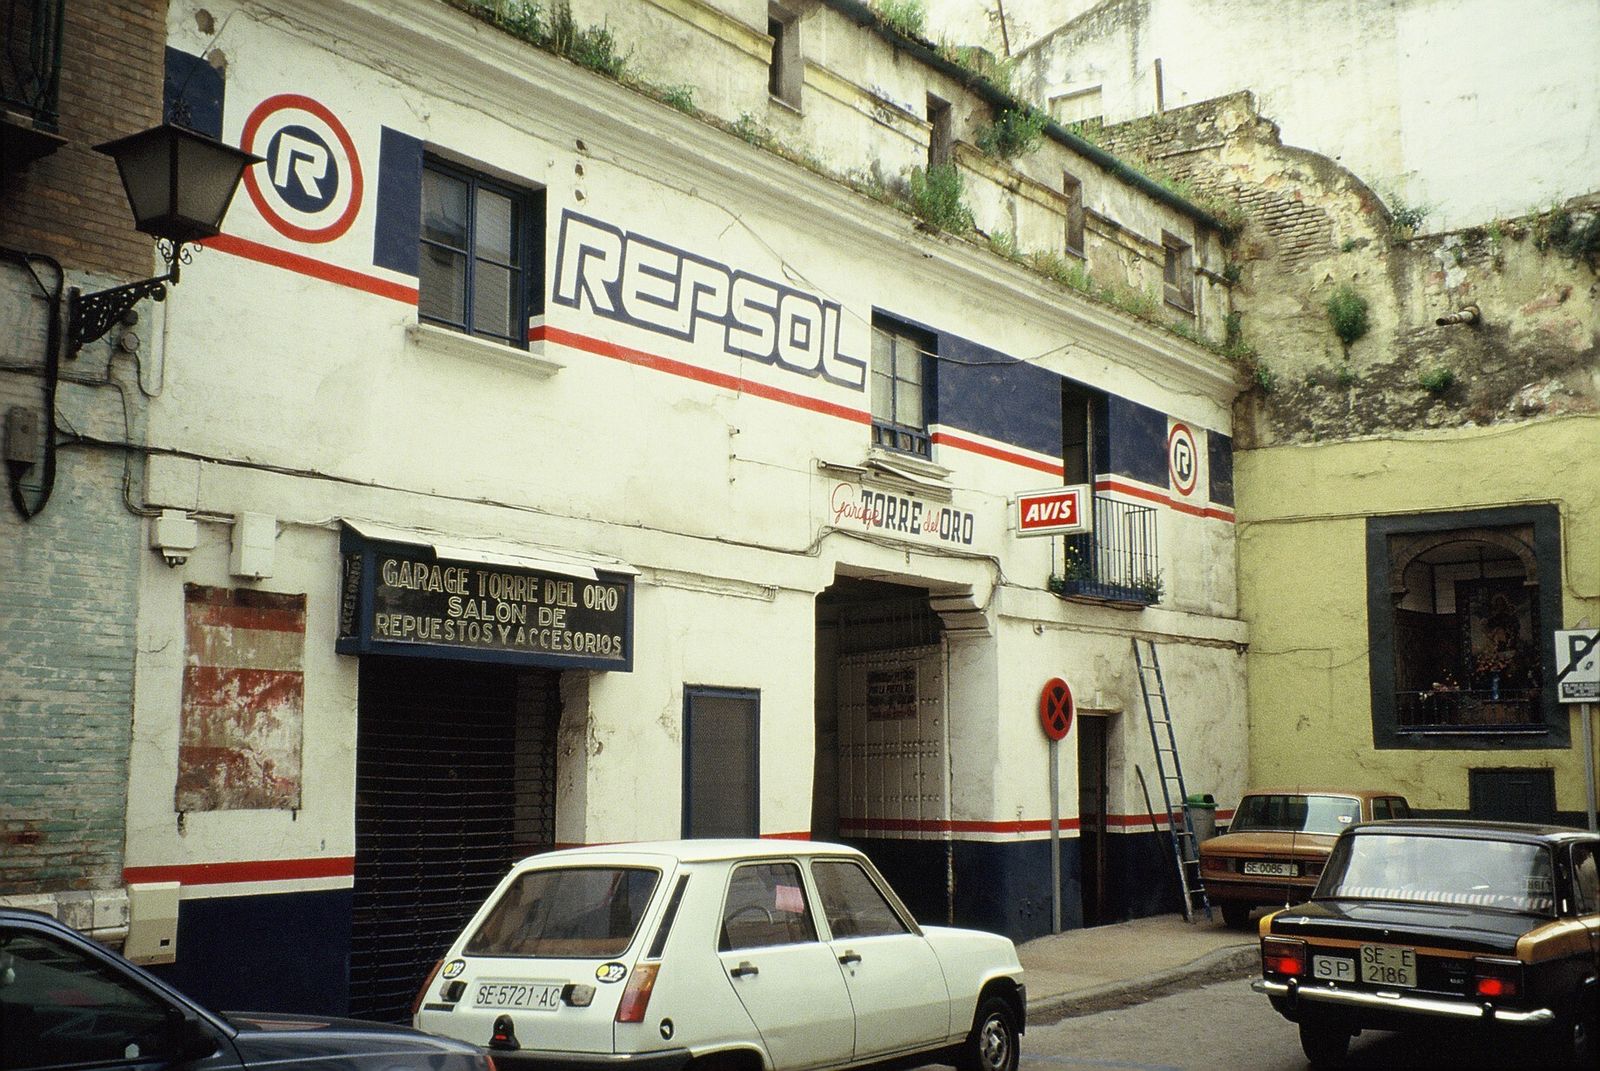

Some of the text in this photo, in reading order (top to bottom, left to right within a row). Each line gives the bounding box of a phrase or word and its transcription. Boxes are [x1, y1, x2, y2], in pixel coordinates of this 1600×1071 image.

[552, 207, 867, 393] REPSOL
[832, 482, 974, 545] Garage TORRE del ORO
[1025, 500, 1073, 522] AVIS
[382, 558, 618, 612] GARAGE TORRE DEL ORO
[375, 613, 622, 655] REPUESTOS Y ACCESORIOS
[538, 606, 566, 629] DE
[1369, 966, 1407, 984] 2186
